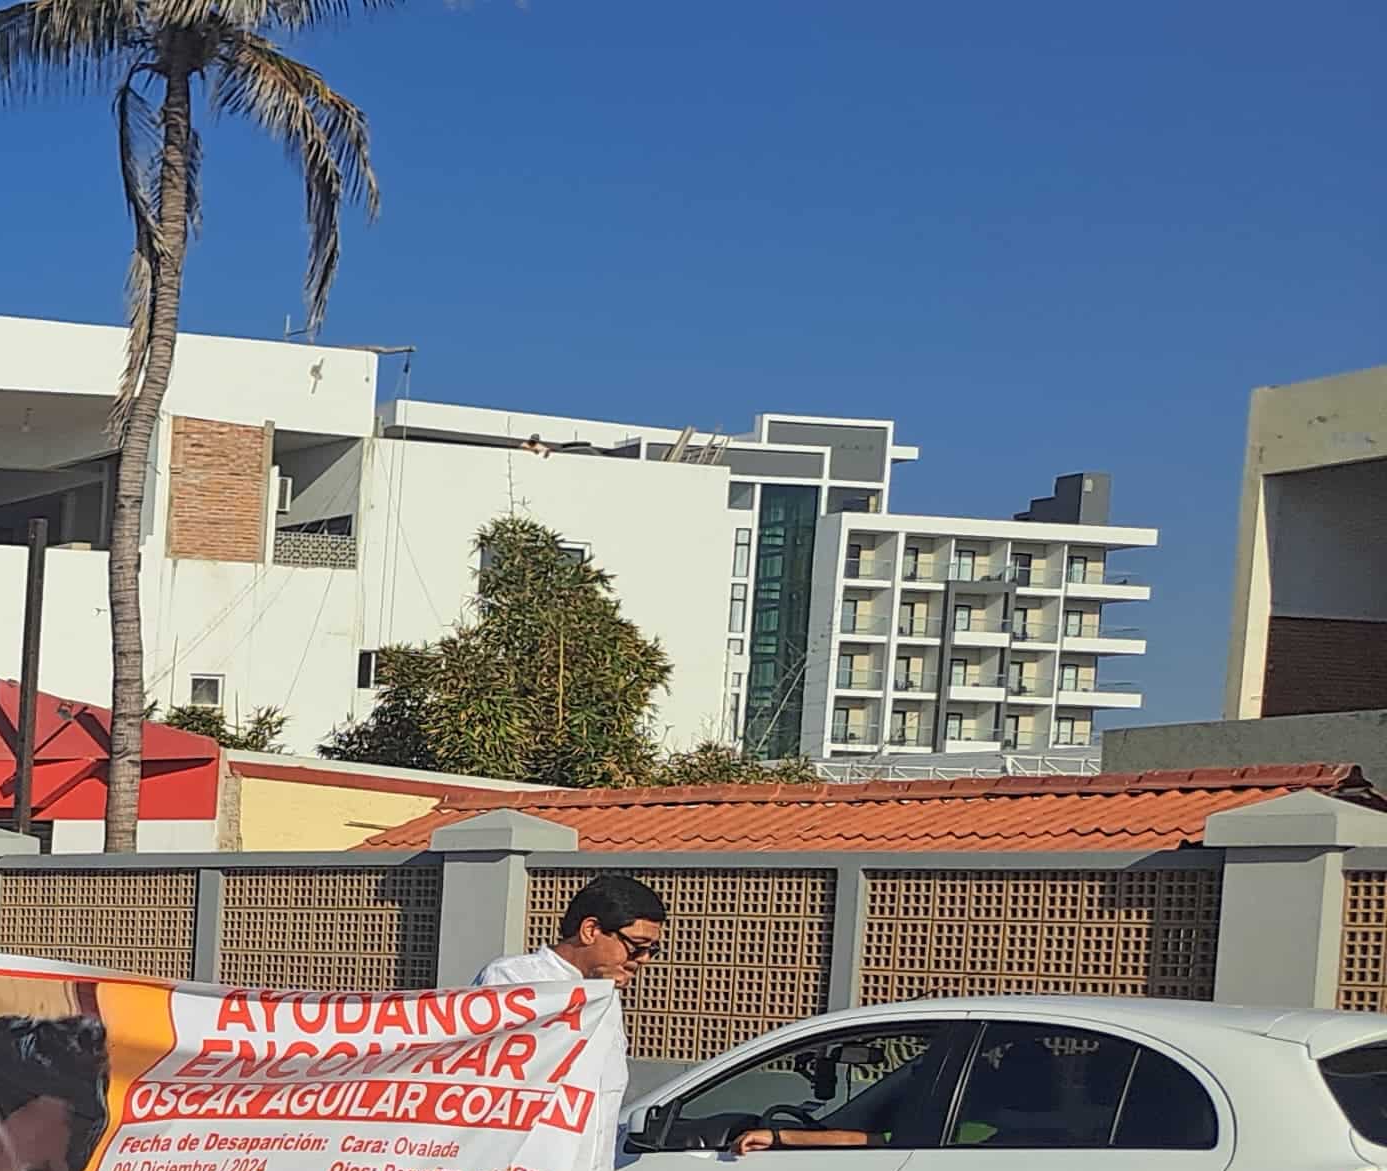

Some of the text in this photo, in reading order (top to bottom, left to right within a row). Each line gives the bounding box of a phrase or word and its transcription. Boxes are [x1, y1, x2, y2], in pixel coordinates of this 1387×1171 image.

[217, 986, 588, 1036] AYUDANOS A
[174, 1034, 539, 1082] ENCONTRAR
[130, 1081, 252, 1119] OSCAR
[260, 1083, 430, 1122] AGUILAR
[118, 1132, 330, 1155] Fecha de Desaparición:
[340, 1135, 460, 1158] Cara: Ovalada
